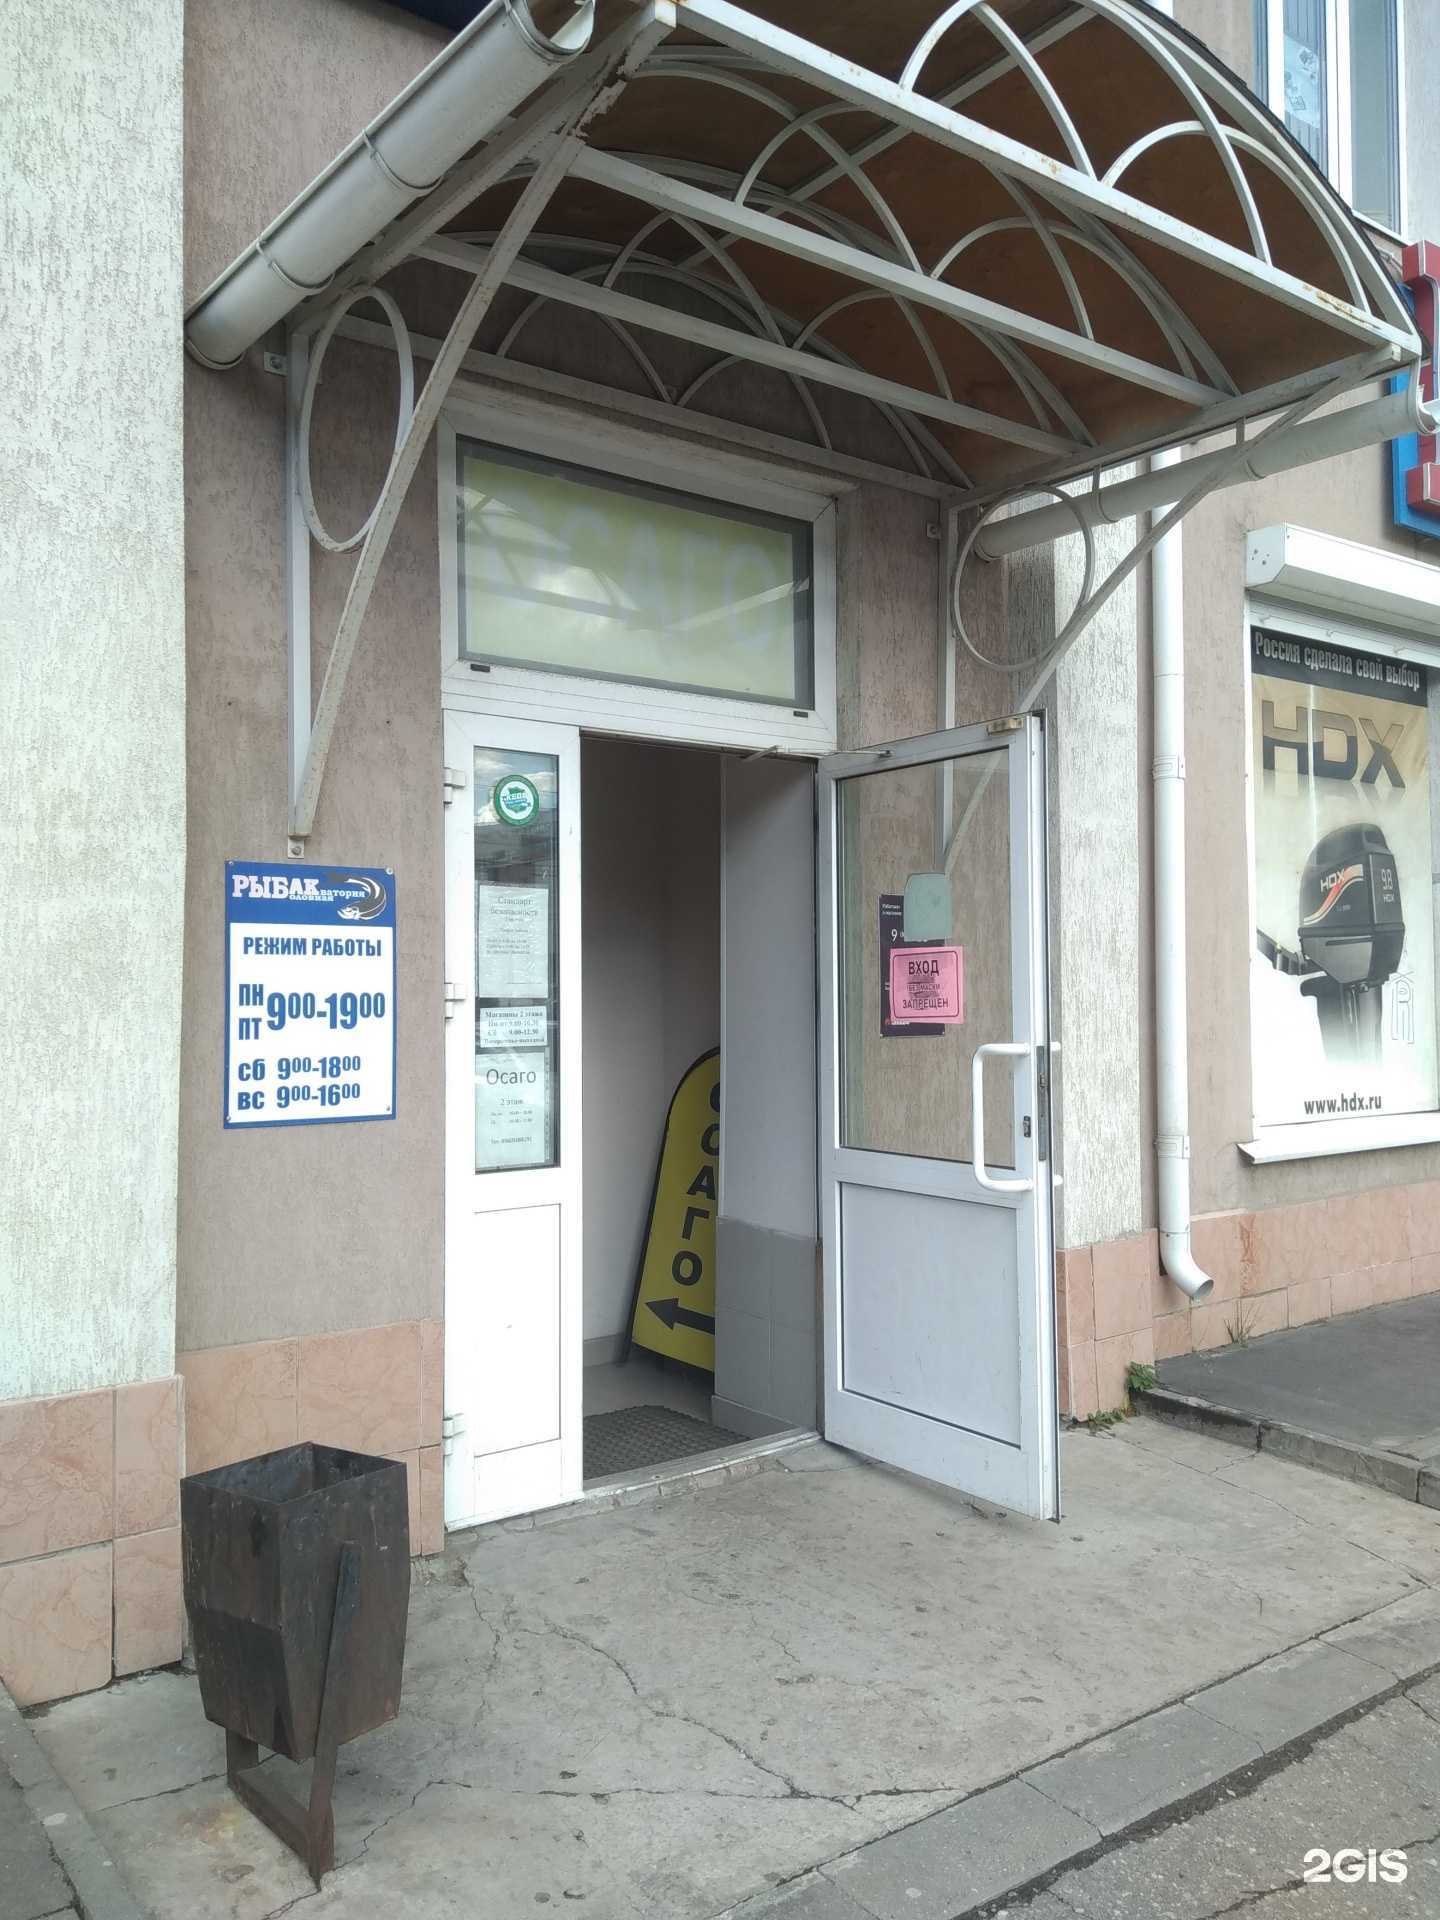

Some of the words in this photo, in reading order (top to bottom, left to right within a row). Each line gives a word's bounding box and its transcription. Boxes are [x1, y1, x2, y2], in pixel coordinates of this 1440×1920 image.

[1255, 631, 1300, 664] Россия
[1304, 646, 1353, 674] сделала
[1355, 658, 1383, 681] свой
[1385, 664, 1420, 692] выбор
[1261, 699, 1406, 788] HDX
[1320, 868, 1345, 892] HDX
[243, 936, 308, 955] РЕЖИМ
[311, 938, 382, 957] РАБОТЫ
[908, 959, 940, 977] ВХОД
[238, 983, 264, 1006] ПН
[902, 997, 949, 1010] ЗАПРЕЩЕН
[238, 1017, 262, 1041] ПТ
[486, 1069, 536, 1085] Осаго
[1304, 1092, 1382, 1115] www.hdx.ru
